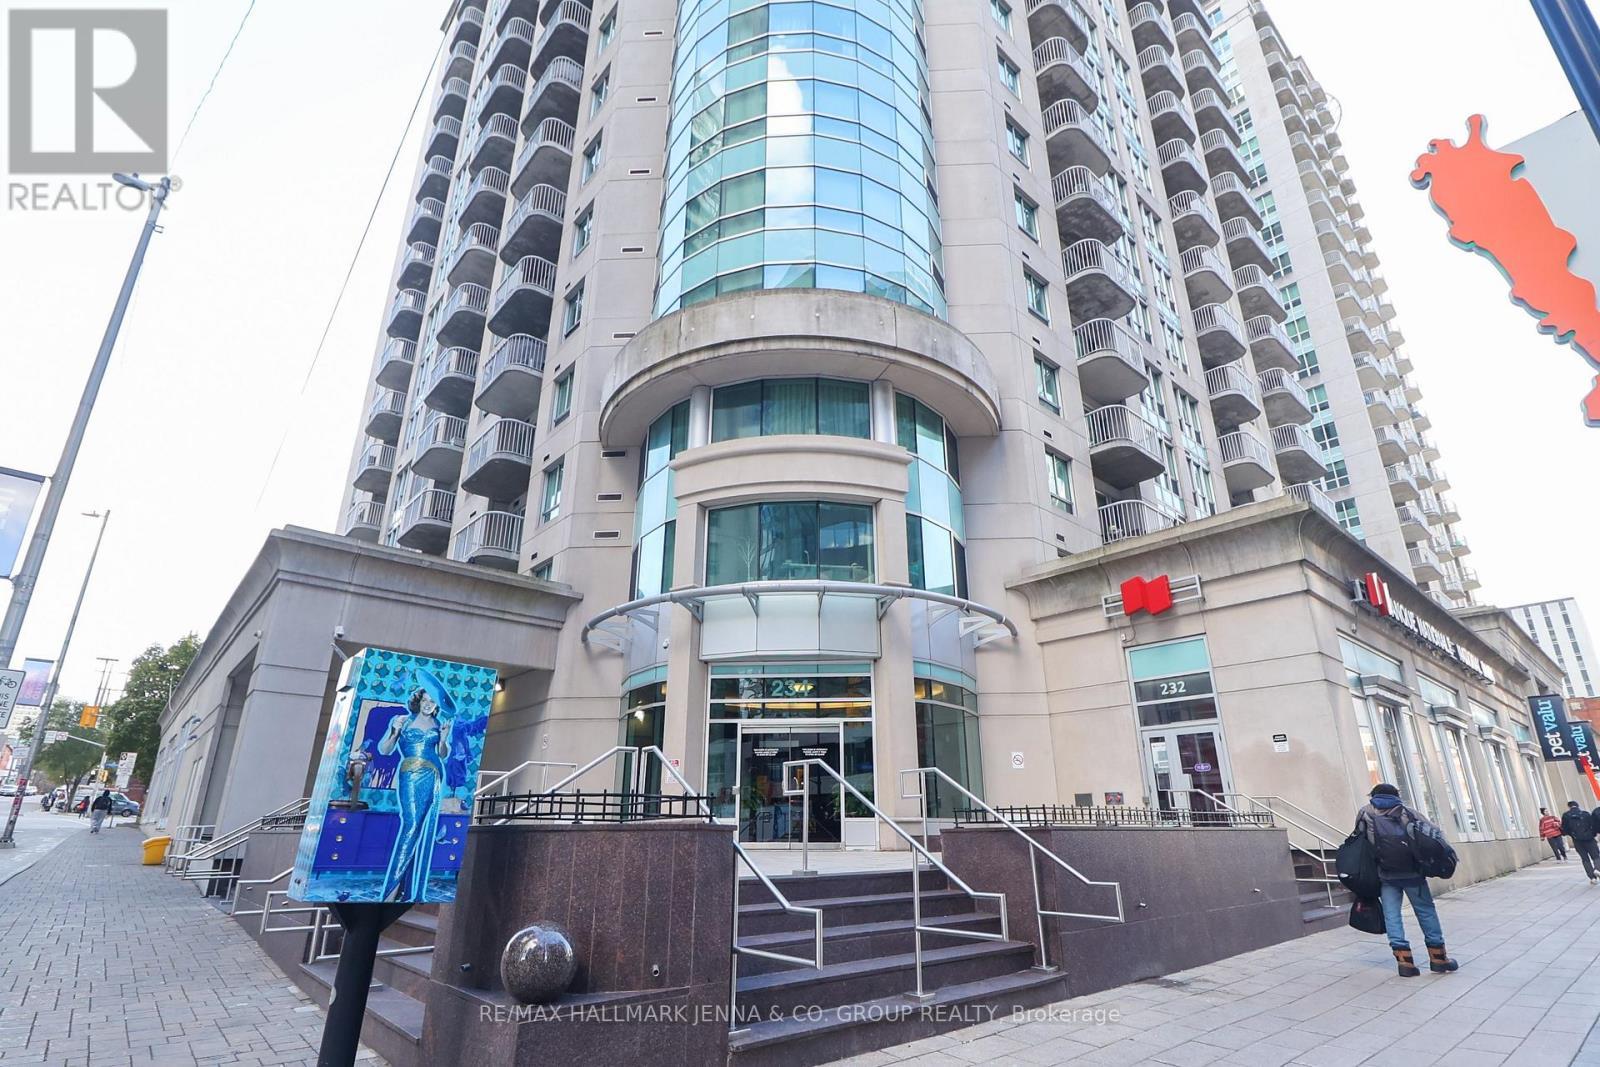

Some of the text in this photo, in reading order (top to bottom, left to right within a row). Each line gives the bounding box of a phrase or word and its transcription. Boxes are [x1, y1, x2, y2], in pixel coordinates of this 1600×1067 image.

[771, 680, 811, 697] 234
[1160, 680, 1186, 696] 232
[1538, 700, 1571, 758] pet valu
[1571, 725, 1588, 751] valu
